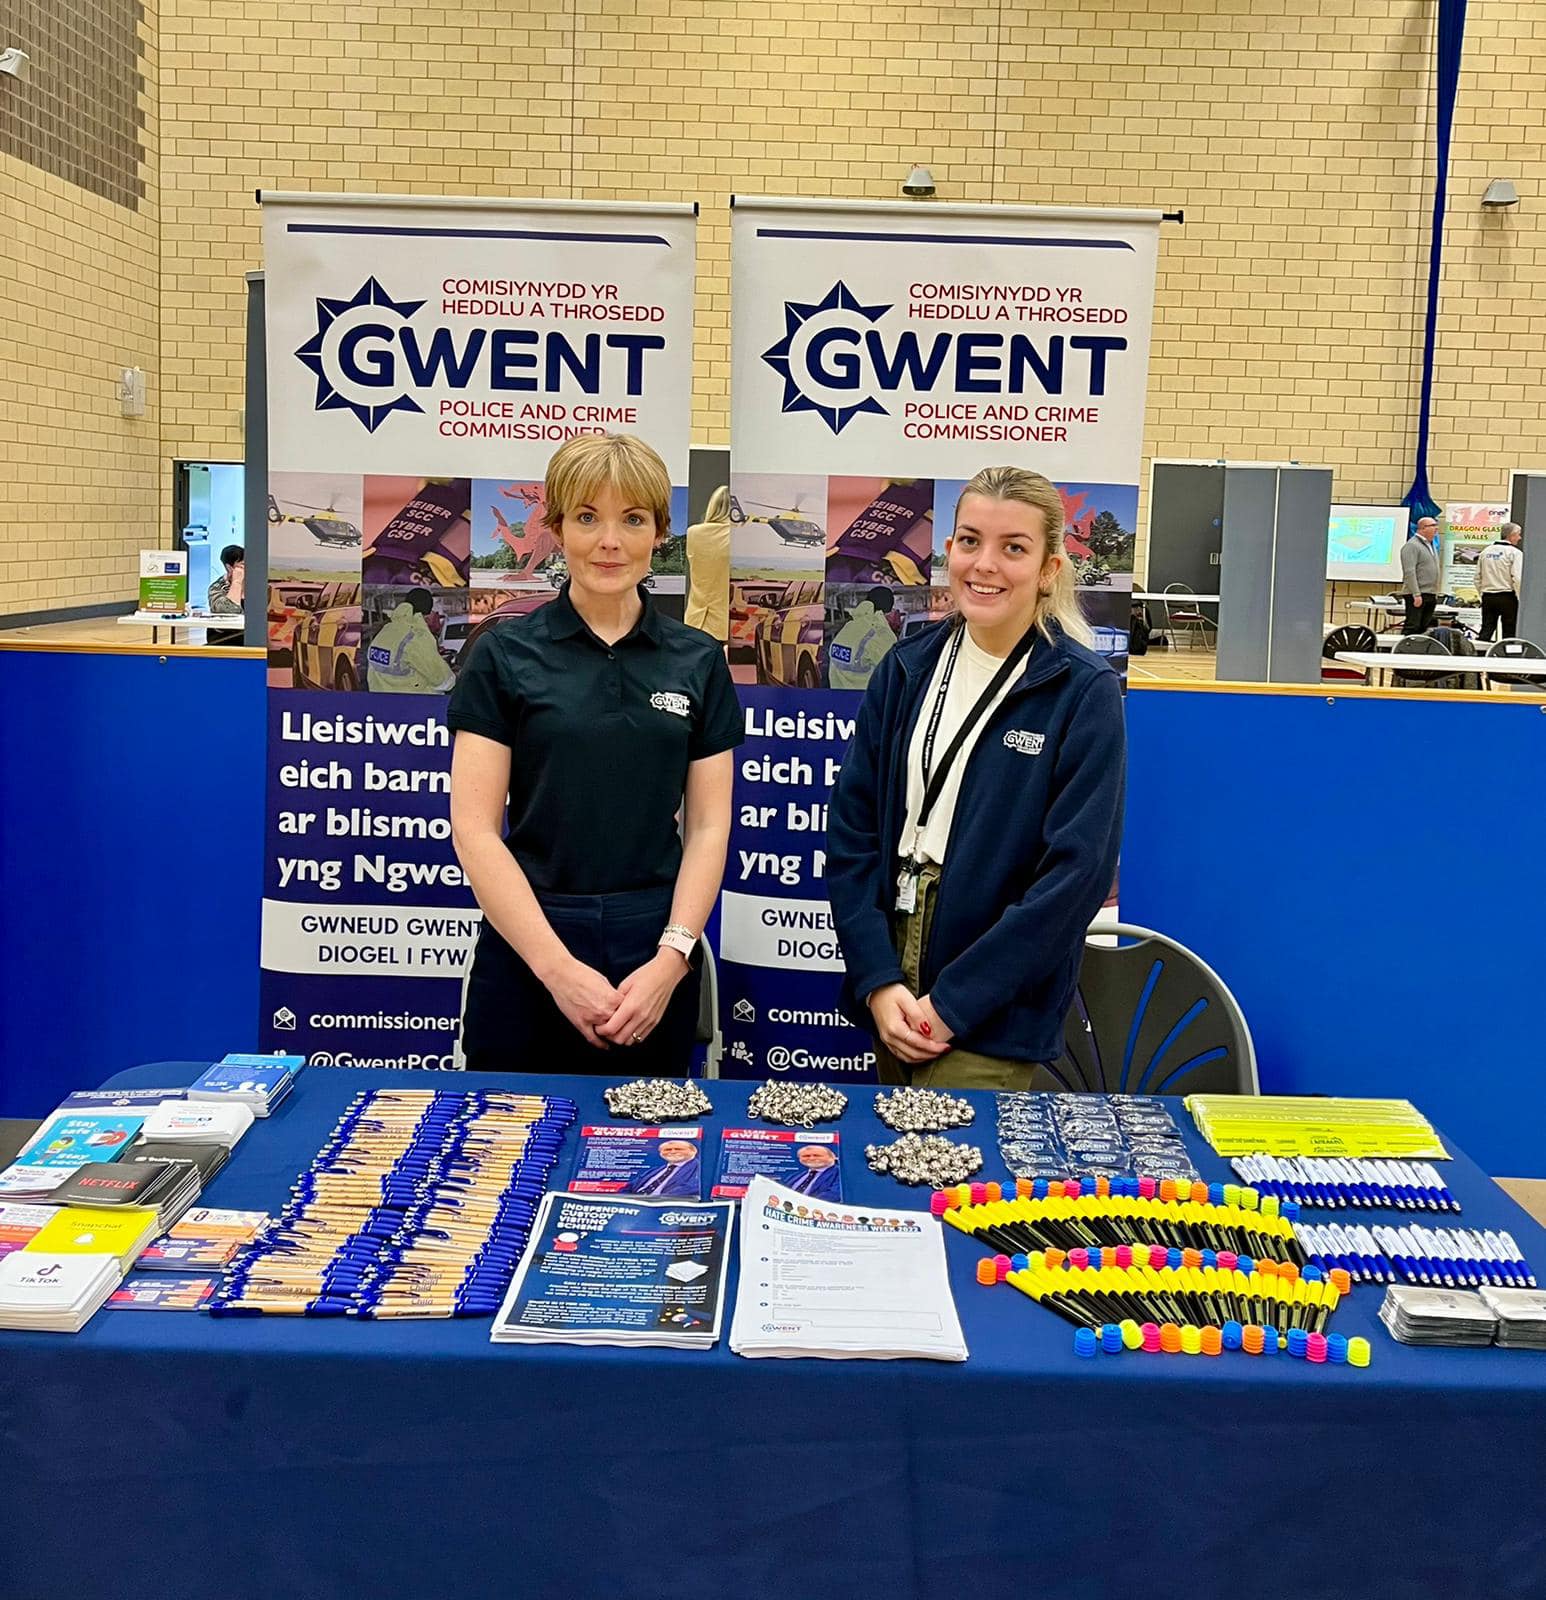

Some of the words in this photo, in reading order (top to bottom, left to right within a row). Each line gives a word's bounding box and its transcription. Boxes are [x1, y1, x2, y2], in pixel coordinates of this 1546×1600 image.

[442, 278, 586, 299] COMISIYNYDD
[591, 284, 618, 300] YR
[909, 283, 1051, 302] COMISIYNYDD
[1055, 287, 1082, 303] YR
[442, 299, 525, 317] HEDDLU
[530, 302, 545, 318] A
[549, 302, 665, 322] THROSEDD
[908, 303, 991, 320] HEDDLU
[995, 305, 1010, 321] A
[1015, 306, 1128, 324] THROSEDD
[338, 323, 666, 396] GWENT
[805, 326, 1128, 396] GWENT
[439, 400, 514, 419] POLICE
[519, 403, 566, 421] AND
[572, 405, 637, 423] CRIME
[905, 403, 977, 420] POLICE
[983, 405, 1029, 421] AND
[1034, 406, 1098, 423] CRIME
[903, 423, 1067, 442] COMMISSIONER
[406, 509, 435, 522] SCC
[869, 509, 897, 522] SCC
[387, 529, 415, 541] CSO
[389, 519, 433, 537] CYBER
[850, 528, 878, 541] CSO
[852, 519, 896, 536] CYBER
[1482, 525, 1504, 533] GLAS
[654, 695, 690, 711] GWENT
[281, 711, 450, 747] Lleisiwch
[1007, 734, 1044, 749] GWENT
[279, 760, 352, 790] eich
[364, 762, 451, 793] barn
[741, 754, 812, 786] eich
[278, 811, 316, 834] ar
[740, 804, 777, 828] ar
[277, 856, 342, 890] yng
[739, 850, 802, 886] yng
[301, 915, 399, 935] GWNEUD
[406, 918, 482, 937] GWENT
[319, 945, 399, 964] DIOGEL
[407, 947, 412, 965] I
[421, 948, 467, 966] FYW
[309, 1010, 460, 1031] commissioner
[766, 1046, 877, 1072] @GwentP
[66, 1119, 98, 1128] Stay
[78, 1177, 140, 1190] NETFLIX
[561, 1209, 614, 1219] CUSTODY
[562, 1202, 640, 1216] INDEPENDENT
[666, 1214, 718, 1223] GWENT
[557, 1222, 604, 1231] SCHEME
[559, 1216, 609, 1225] VISITING
[765, 1208, 786, 1223] HATE
[787, 1214, 815, 1228] CRIME
[816, 1220, 870, 1232] AWARENESS
[871, 1225, 896, 1233] WEEK
[898, 1225, 921, 1233] 2022
[20, 1276, 61, 1284] TikTok
